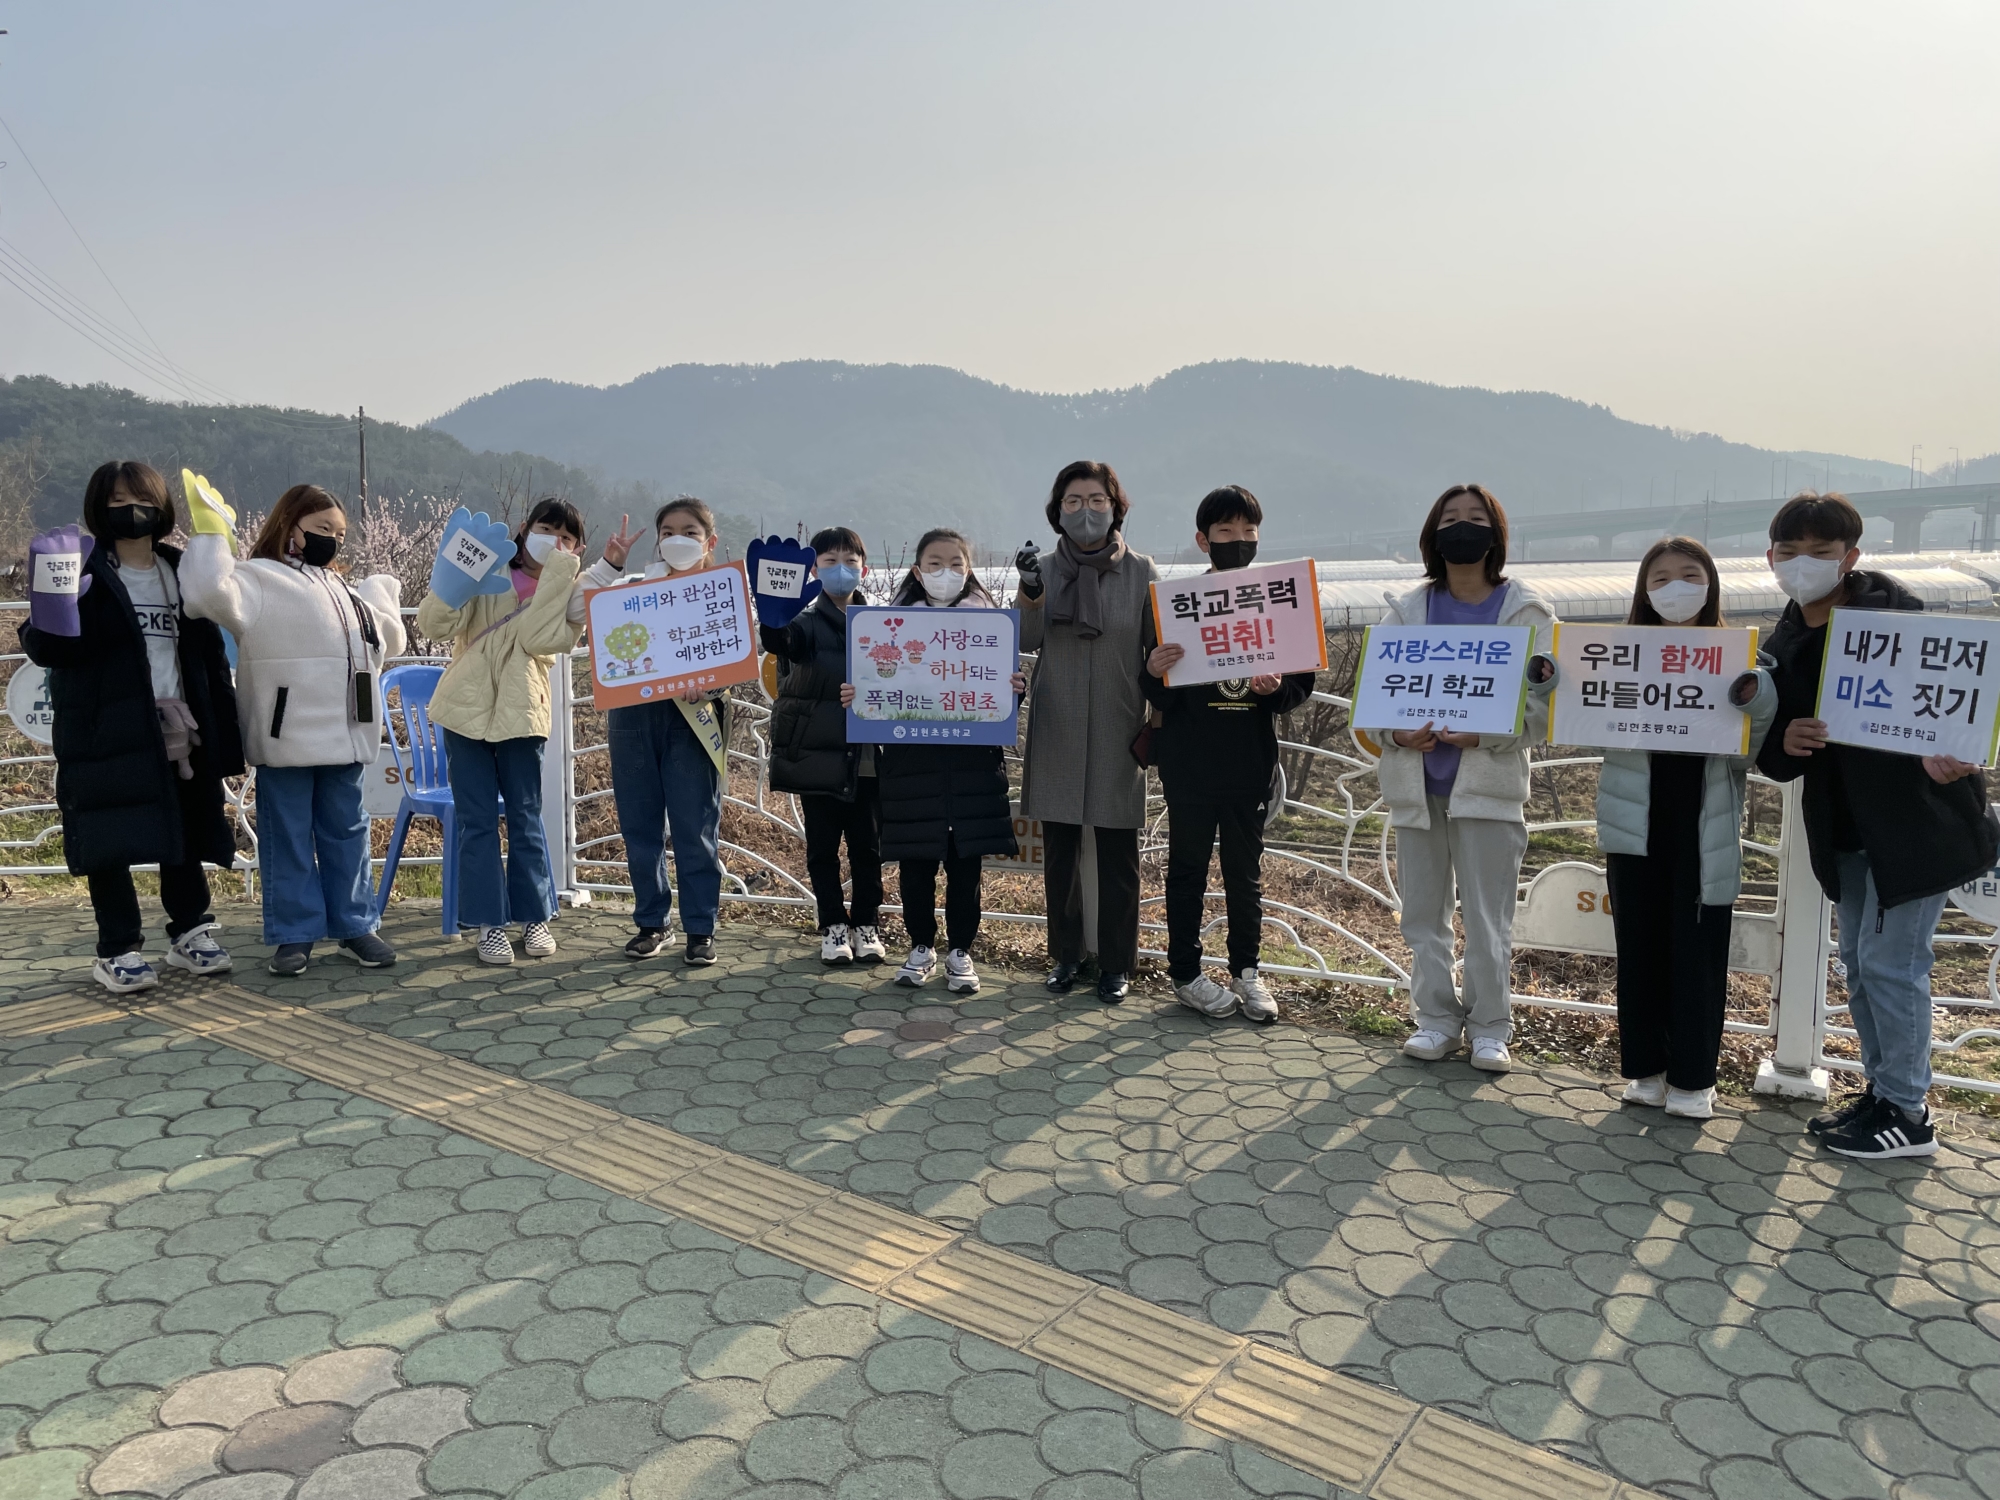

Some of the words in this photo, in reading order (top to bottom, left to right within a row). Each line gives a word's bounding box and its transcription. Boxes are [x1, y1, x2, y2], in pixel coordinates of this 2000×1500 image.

[456, 550, 476, 569] 멈춰!
[460, 537, 488, 562] 학교폭력
[46, 561, 77, 573] 학교폭력
[766, 566, 797, 580] 학교폭력
[623, 590, 677, 614] 배려와
[682, 577, 733, 603] 관심이
[770, 580, 791, 591] 멈춰!
[705, 596, 736, 617] 모여
[1171, 577, 1298, 623] 학교폭력
[667, 615, 738, 645] 학교폭력
[929, 629, 999, 651] 사랑으로
[1200, 618, 1275, 656] 멈춰!
[675, 635, 742, 663] 예방한다
[1216, 652, 1275, 667] 집현초등학교
[1378, 639, 1512, 665] 자랑스러운
[1580, 643, 1641, 672] 우리
[1660, 644, 1723, 675] 함께
[1843, 630, 1902, 667] 내가
[1920, 636, 1988, 676] 먼저
[929, 659, 998, 682] 하나되는
[656, 674, 716, 694] 집현초등학교
[1381, 673, 1434, 698] 우리
[1442, 674, 1495, 699] 학교
[864, 689, 934, 711] 폭력없는
[938, 690, 998, 712] 집현초
[1581, 680, 1715, 711] 만들어요.
[1836, 675, 1894, 710] 미소
[1912, 683, 1980, 725] 짓기
[25, 713, 53, 725] 어린
[1406, 708, 1468, 719] 집현초등학교
[910, 728, 971, 738] 집현초등학교
[1617, 721, 1689, 735] 집현초등학교
[1869, 722, 1937, 742] 집현초등학교
[1962, 881, 1998, 897] 어린
